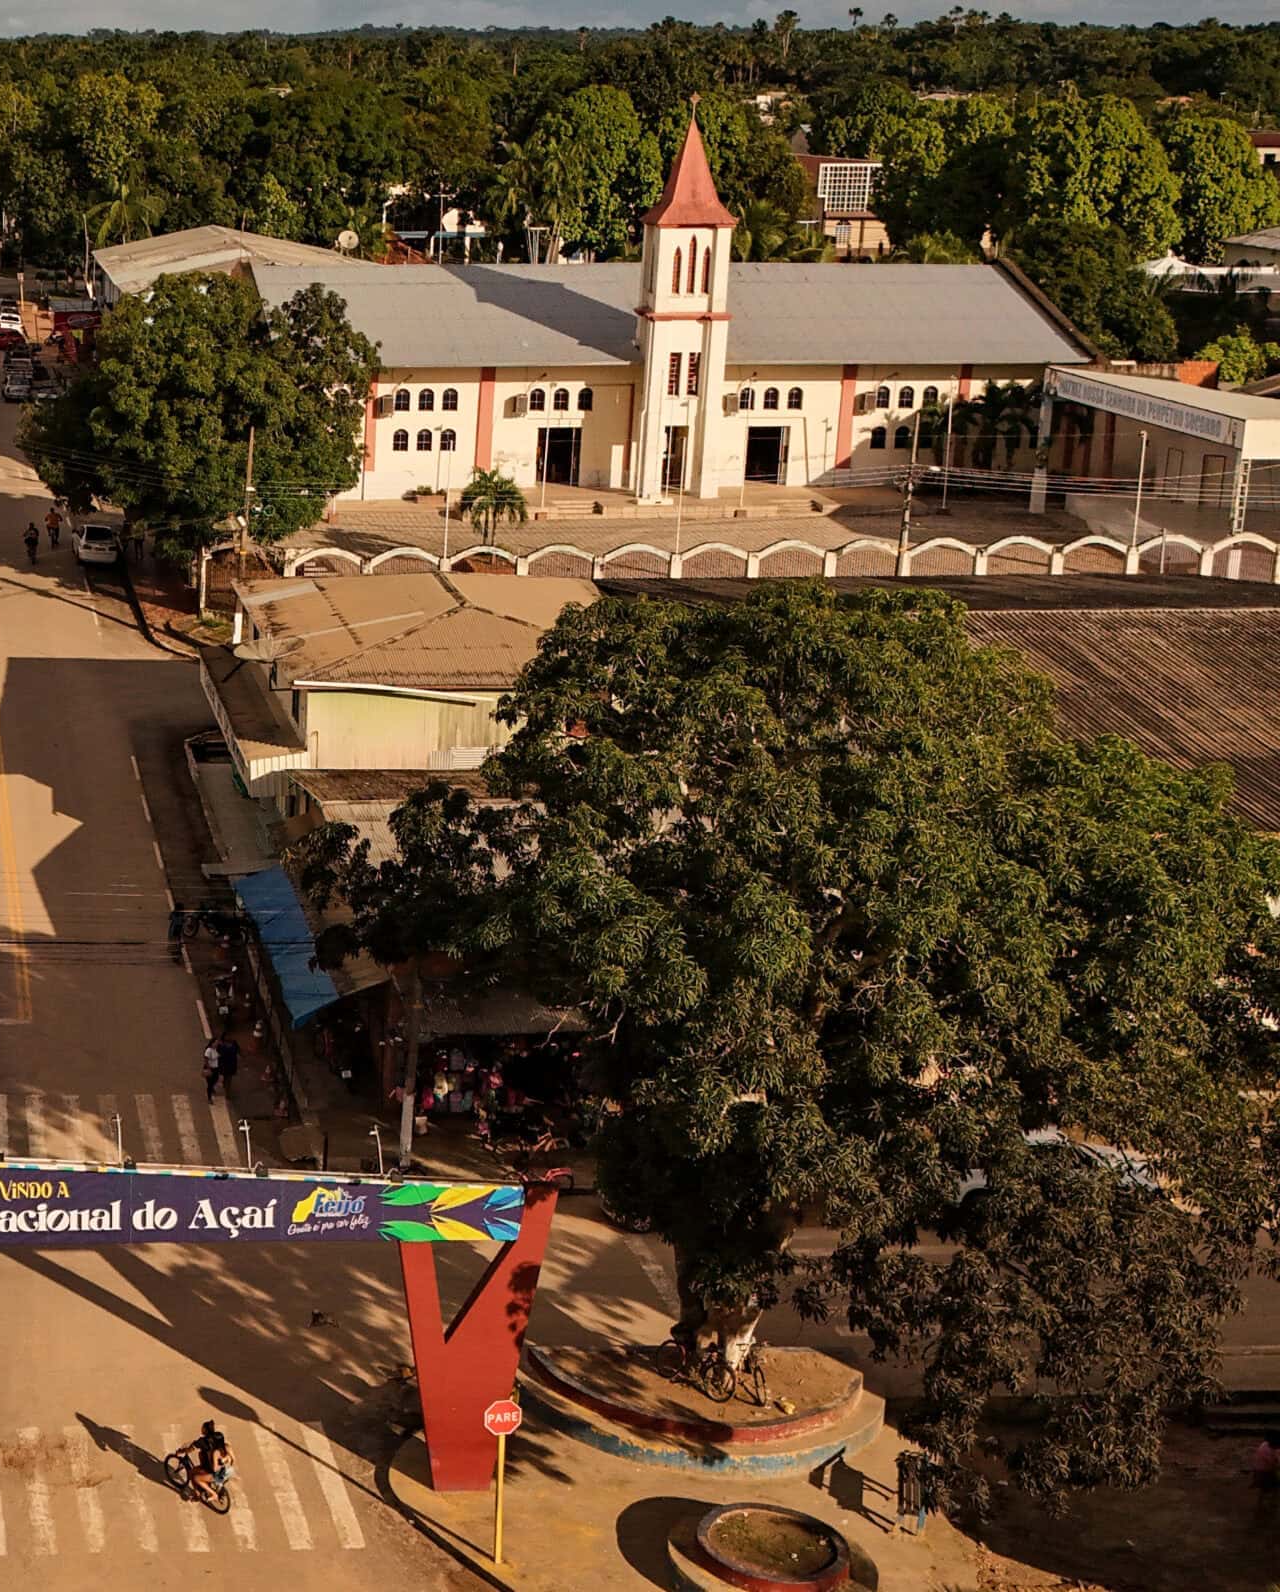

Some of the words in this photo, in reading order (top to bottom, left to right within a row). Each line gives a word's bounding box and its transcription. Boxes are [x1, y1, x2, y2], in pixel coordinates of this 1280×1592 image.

[56, 1181, 69, 1198] A
[312, 1192, 367, 1217] Feijó
[131, 1200, 179, 1231] do
[188, 1199, 277, 1239] Açaí
[487, 1411, 519, 1424] PARE
